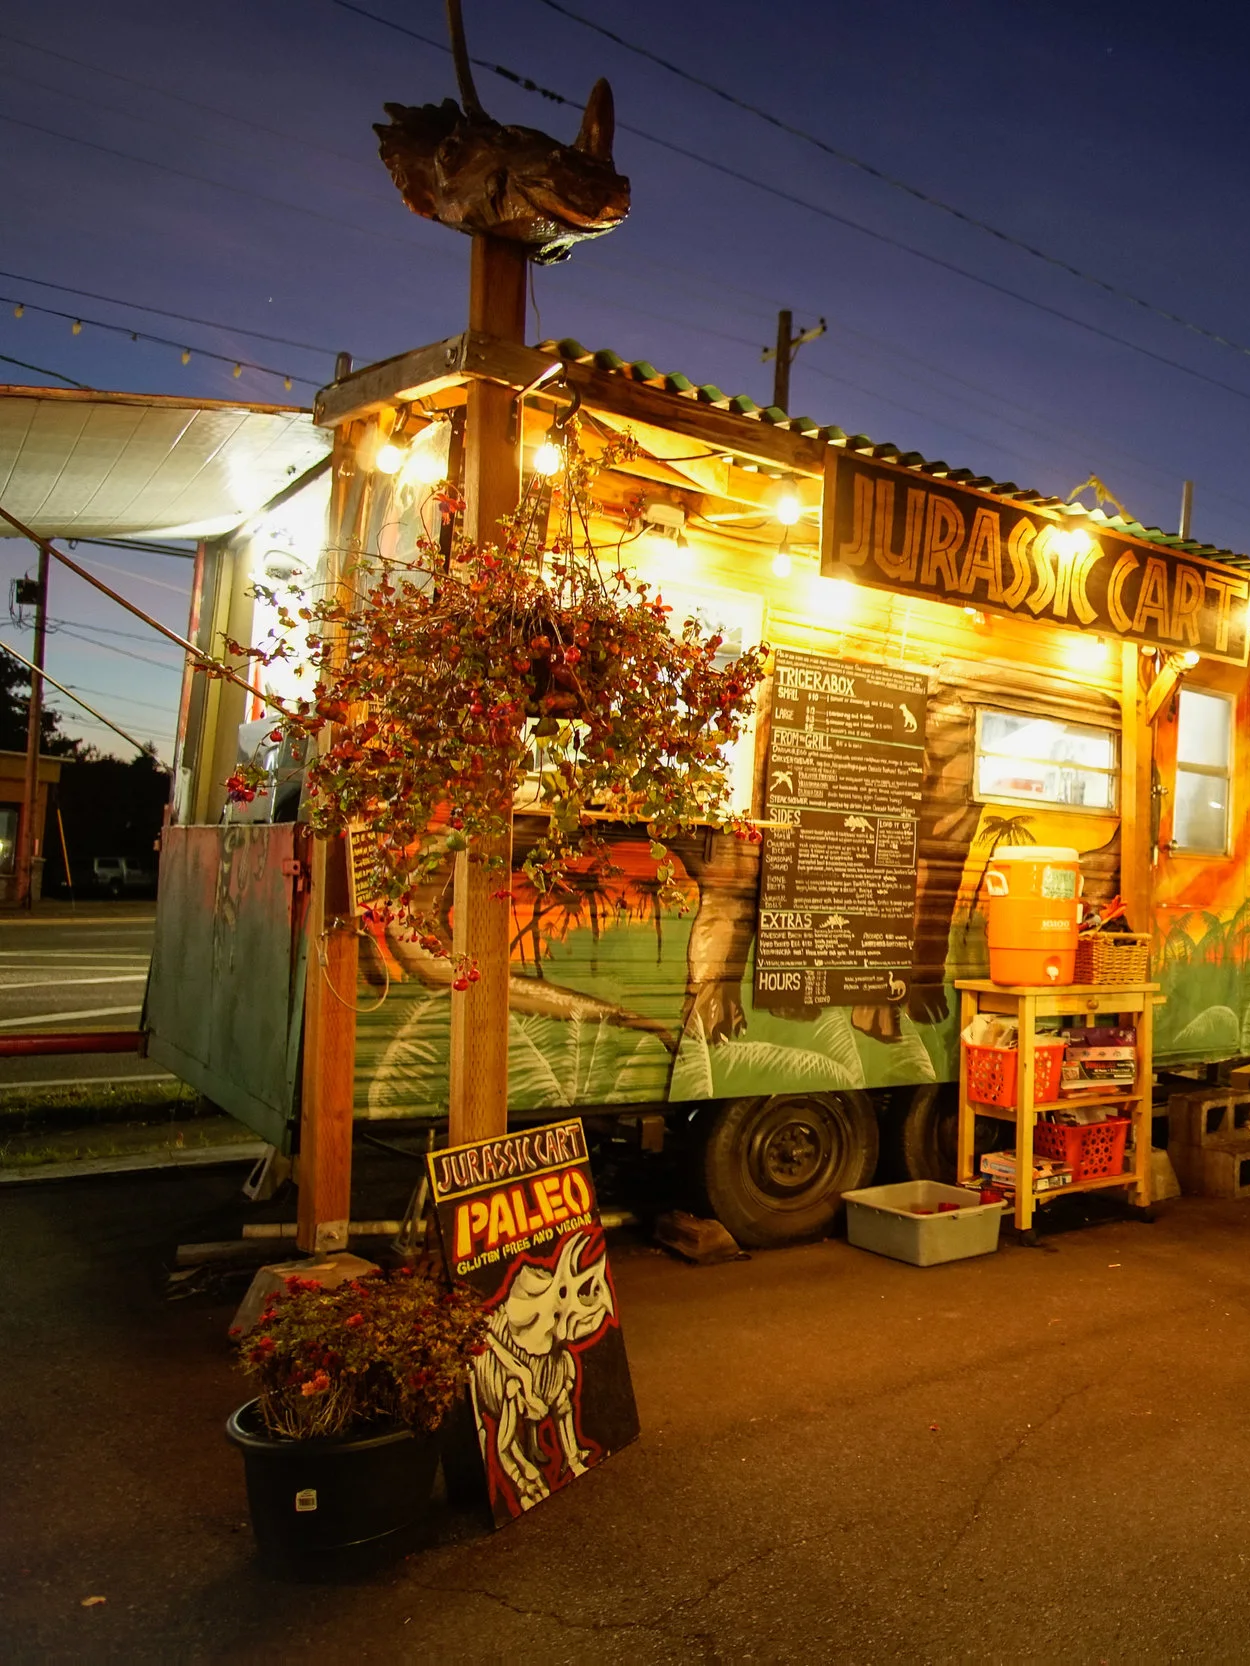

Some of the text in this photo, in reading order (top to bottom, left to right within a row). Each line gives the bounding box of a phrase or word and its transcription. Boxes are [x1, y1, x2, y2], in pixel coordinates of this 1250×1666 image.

[839, 472, 1250, 652] JURASSIC CART
[776, 667, 855, 697] TRICERABOX
[778, 687, 799, 701] SMALL
[775, 707, 794, 720] LARGE
[773, 730, 799, 746] FROM
[805, 735, 832, 750] GRILL
[770, 808, 801, 824] SIDES
[761, 912, 812, 928] EXTRAS
[759, 972, 801, 991] HOURS
[437, 1126, 582, 1194] JURASSIC CART
[456, 1171, 591, 1258] PALEO
[457, 1212, 592, 1276] GLUTEN FREE AND VEGAN
